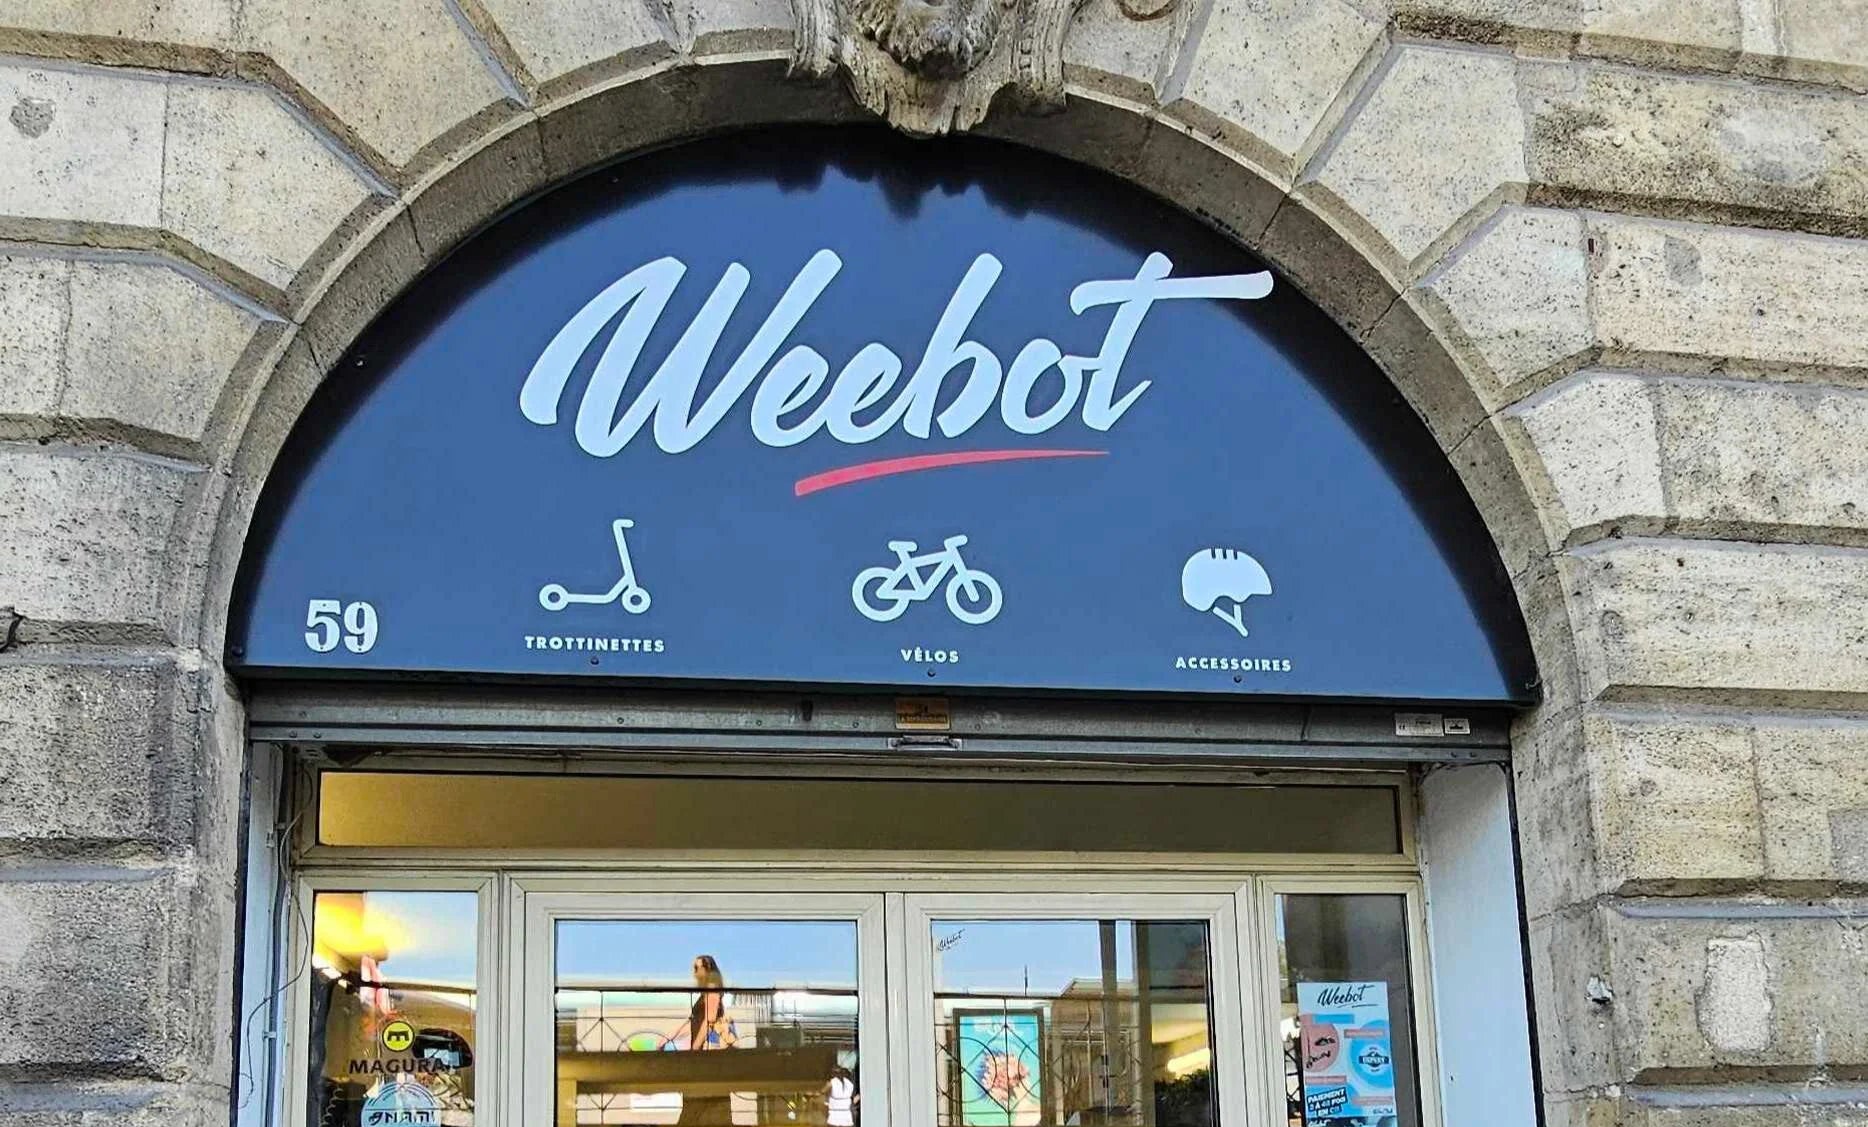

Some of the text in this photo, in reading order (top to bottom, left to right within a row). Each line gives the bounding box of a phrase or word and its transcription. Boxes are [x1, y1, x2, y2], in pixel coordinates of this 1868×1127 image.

[519, 249, 1274, 458] Weebot
[305, 599, 379, 654] 59
[524, 635, 665, 652] TROTTINETTES
[901, 647, 960, 663] VÉLOS
[1175, 656, 1292, 671] ACCESSOIRES
[1317, 984, 1375, 1006] Weebot
[349, 1059, 447, 1074] MAGURA
